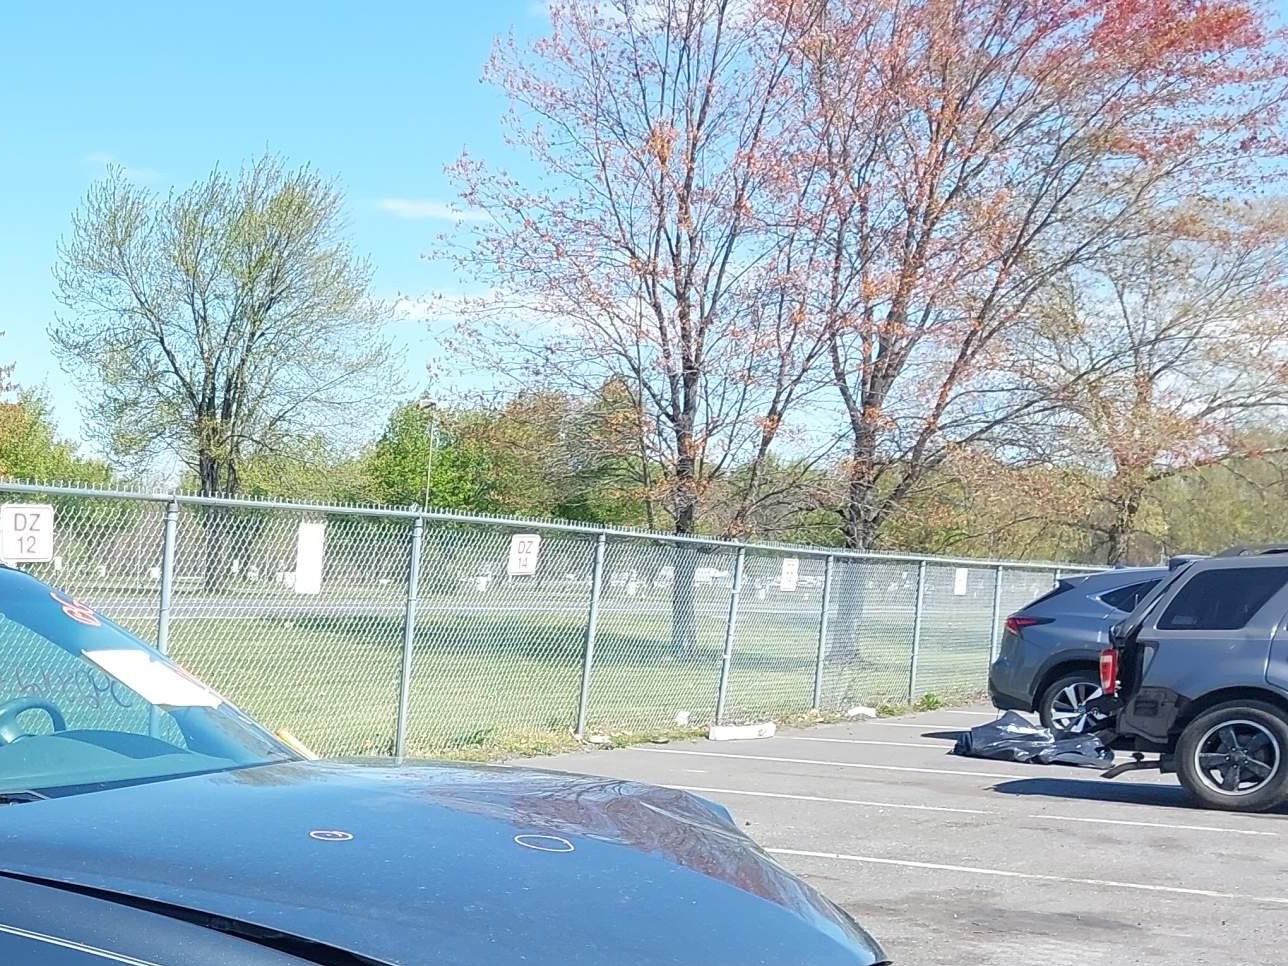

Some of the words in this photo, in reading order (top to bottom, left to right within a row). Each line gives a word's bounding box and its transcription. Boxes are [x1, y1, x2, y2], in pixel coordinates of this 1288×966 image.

[14, 513, 41, 532] DZ
[17, 535, 37, 554] 12
[518, 540, 533, 554] DZ
